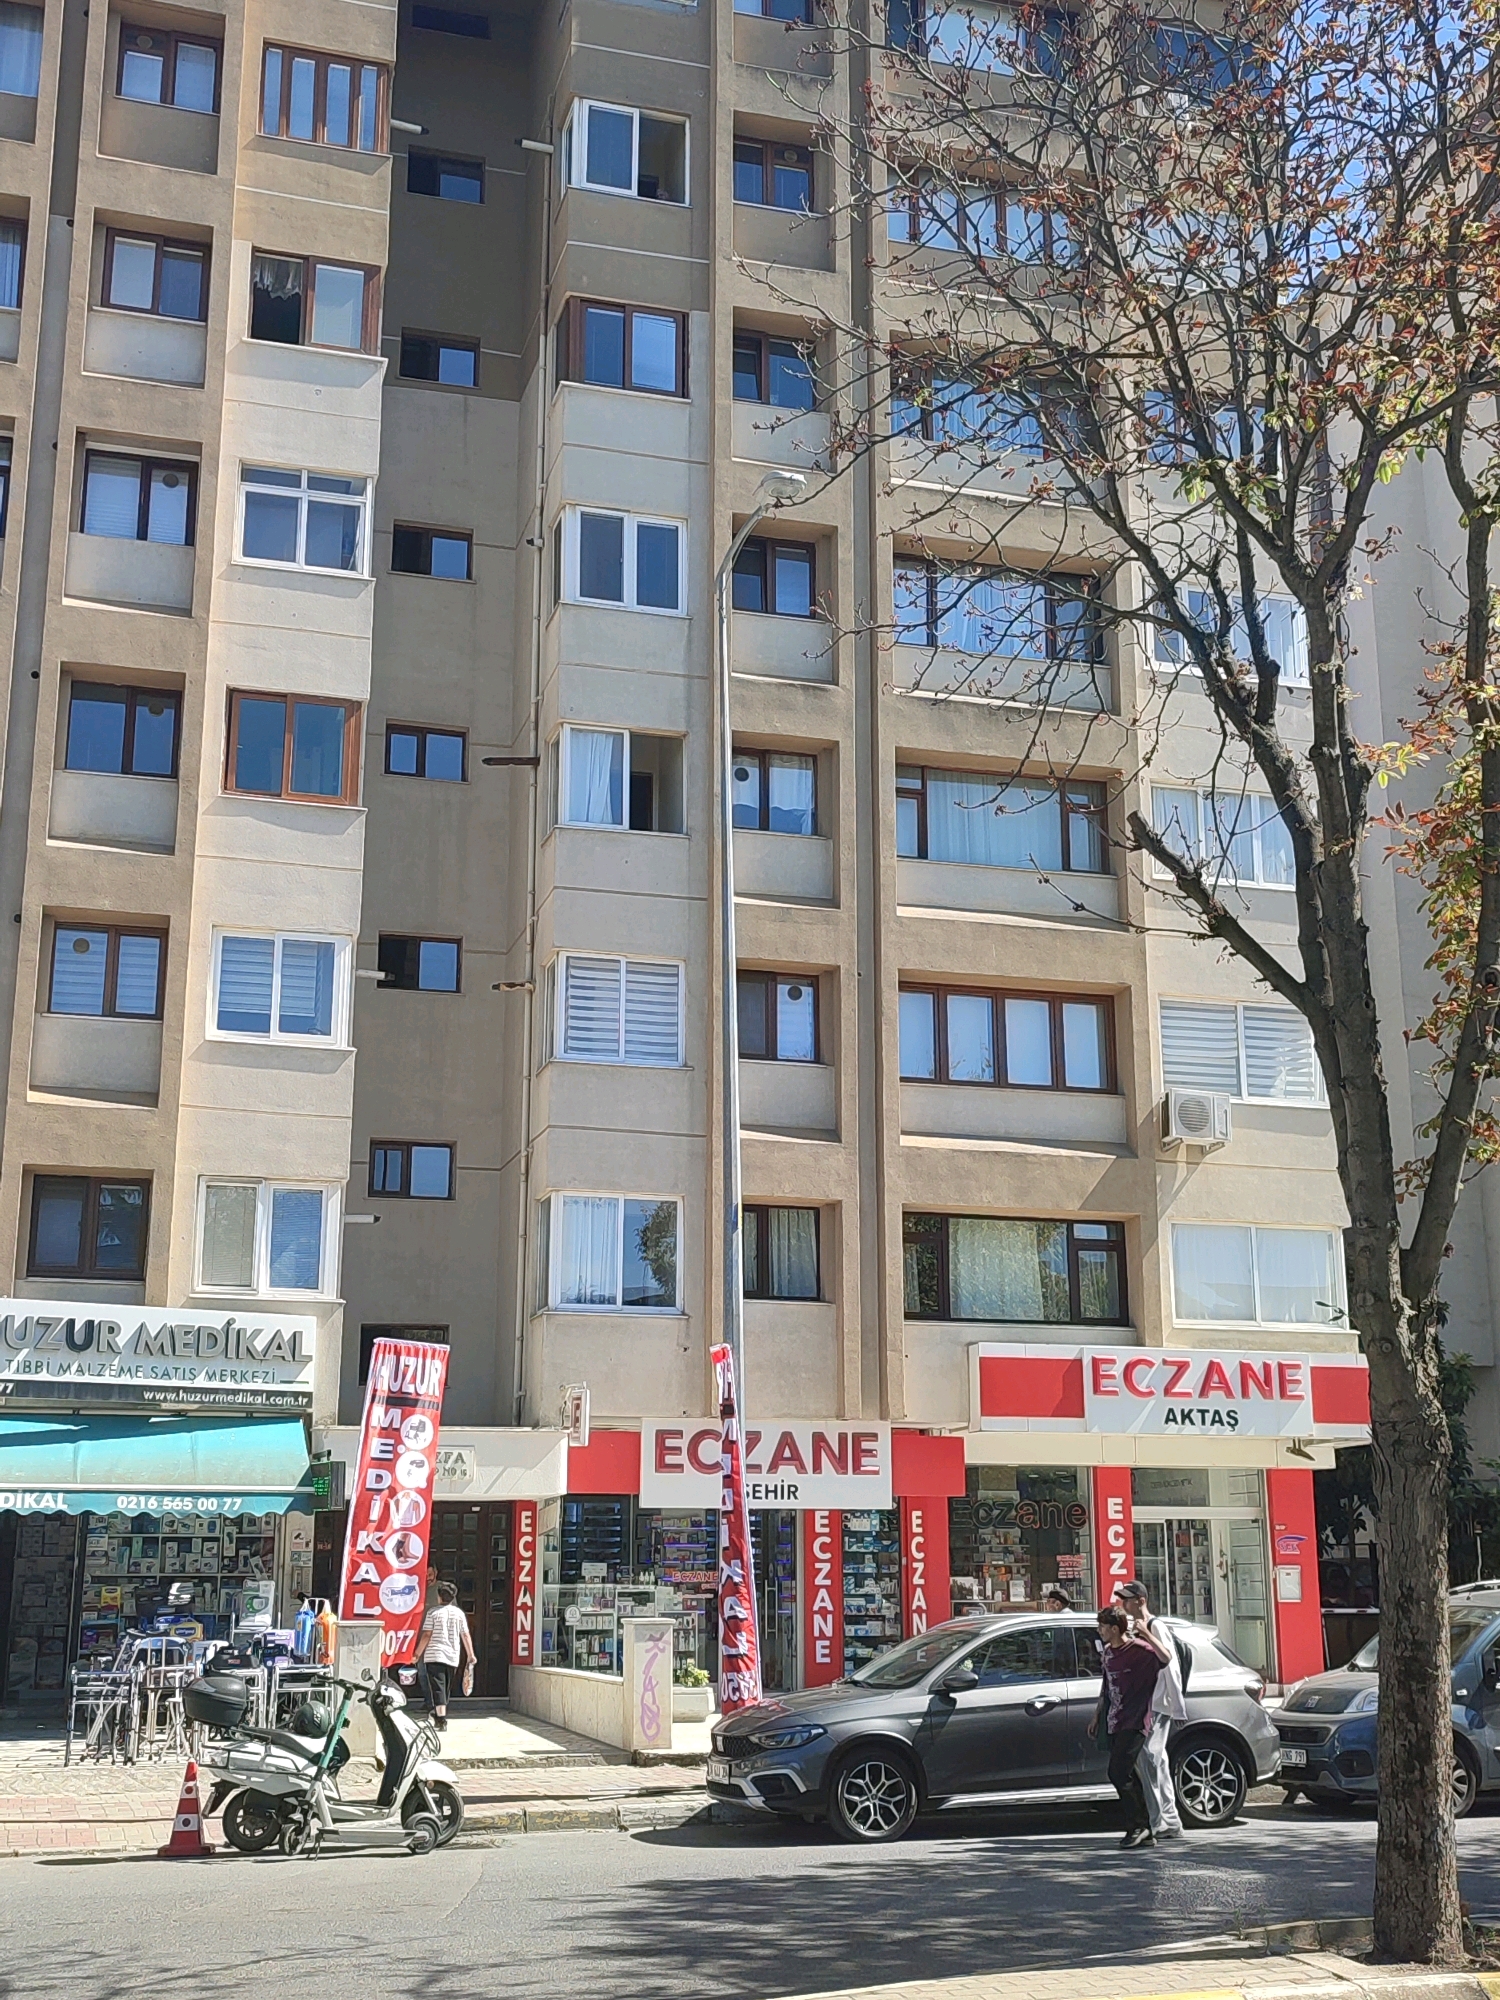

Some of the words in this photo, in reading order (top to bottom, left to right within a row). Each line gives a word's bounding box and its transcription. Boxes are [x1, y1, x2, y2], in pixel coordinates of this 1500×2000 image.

[0, 1313, 122, 1354] UZUR
[130, 1317, 312, 1362] MEDİKAL
[5, 1356, 50, 1374] TIBBİ
[57, 1362, 144, 1380] MALZEME
[150, 1365, 197, 1384] SATIŞ
[203, 1368, 276, 1384] MERKEZİ
[375, 1354, 442, 1397] HUZUR
[1091, 1355, 1305, 1401] ECZANE
[143, 1389, 309, 1406] www.huzurmedikal.com.tr
[1164, 1408, 1239, 1431] AKTAŞ
[655, 1429, 880, 1475] ECZANE
[117, 1496, 158, 1509] 0216
[162, 1497, 193, 1511] 565
[197, 1497, 218, 1511] 00
[222, 1497, 242, 1511] 77
[950, 1500, 1088, 1529] Eczane
[516, 1510, 534, 1657] ECZANE
[812, 1510, 834, 1664] ECZANE
